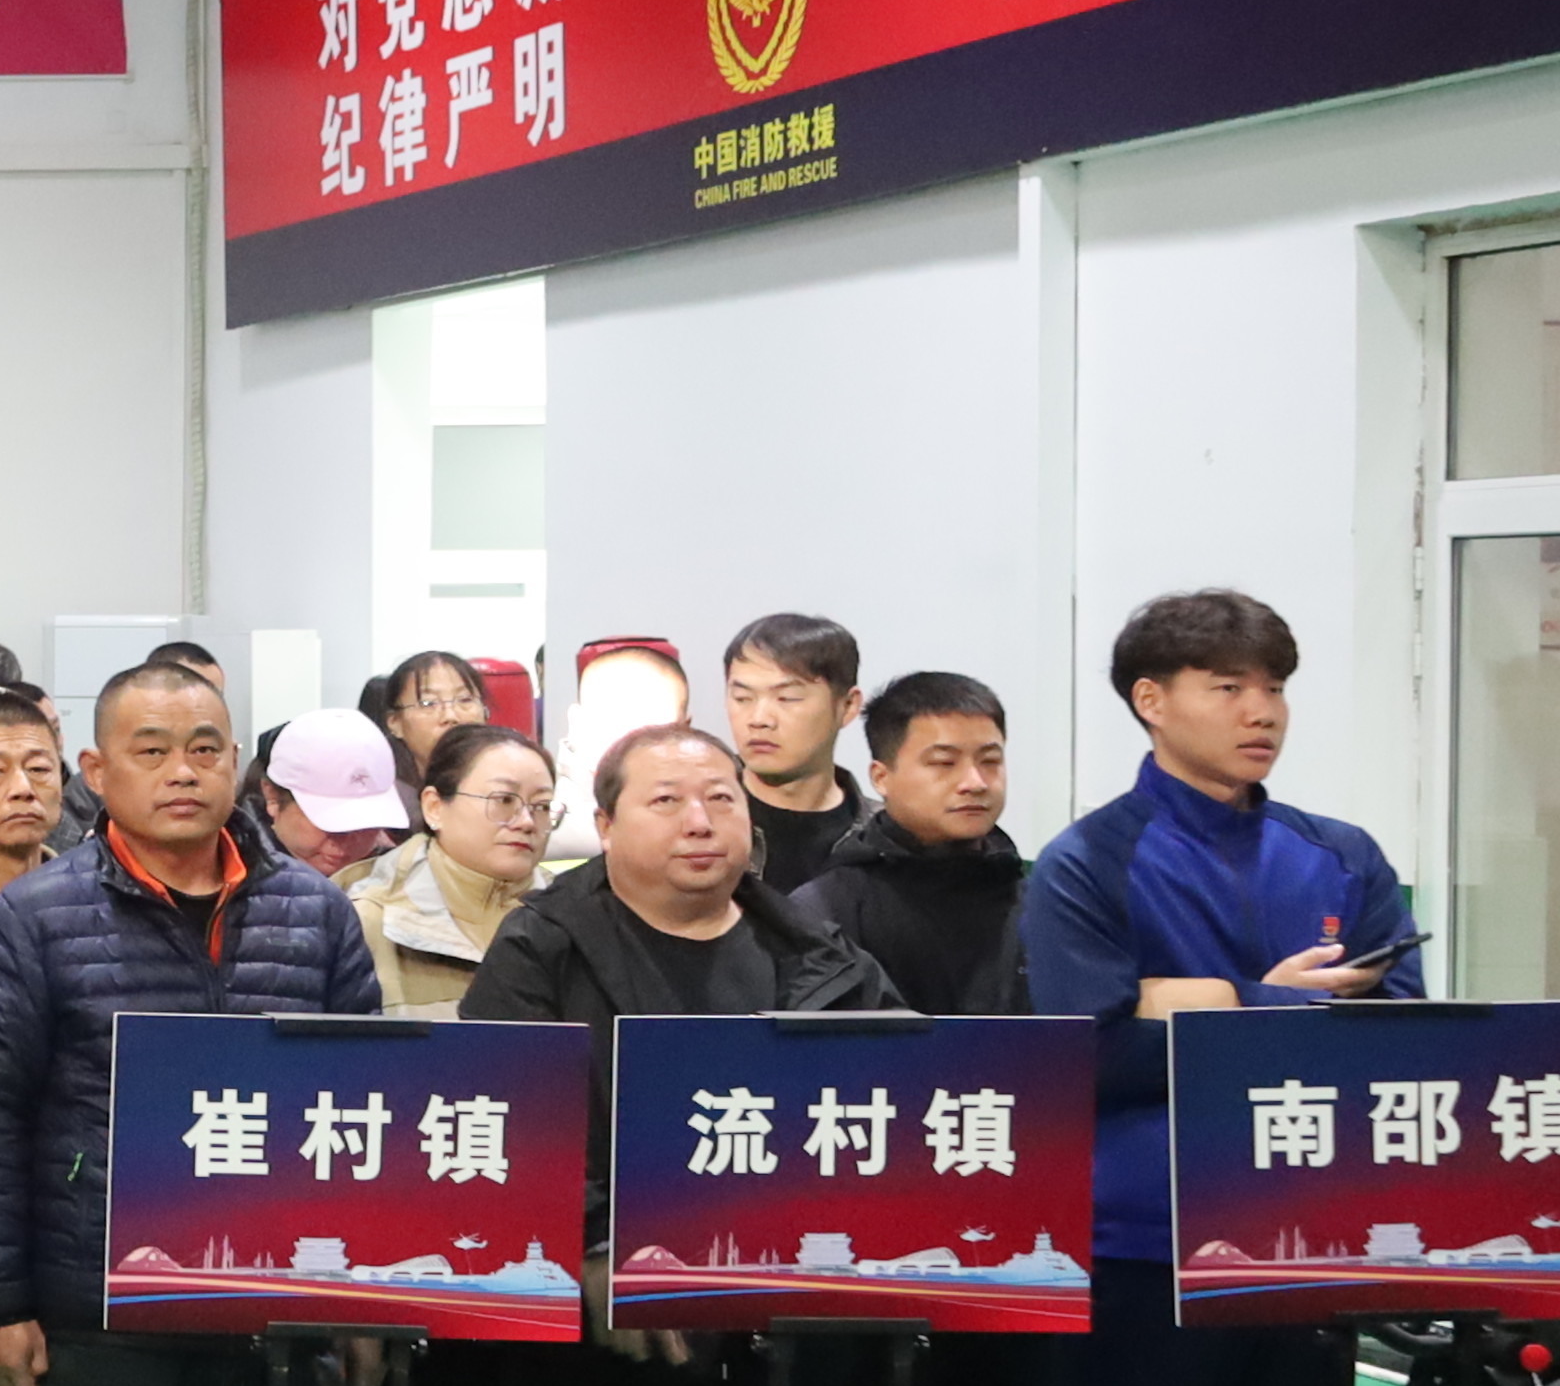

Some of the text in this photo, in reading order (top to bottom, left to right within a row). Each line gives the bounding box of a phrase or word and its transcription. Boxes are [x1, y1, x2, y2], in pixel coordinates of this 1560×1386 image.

[321, 23, 564, 195] 纪律严明
[694, 103, 835, 179] 中国消防救援
[694, 157, 838, 209] CHINA FIRE AND RESCUE
[182, 1089, 508, 1184] 崔村镇
[688, 1088, 1015, 1176] 流村镇
[1249, 1074, 1560, 1168] 南邵镇
